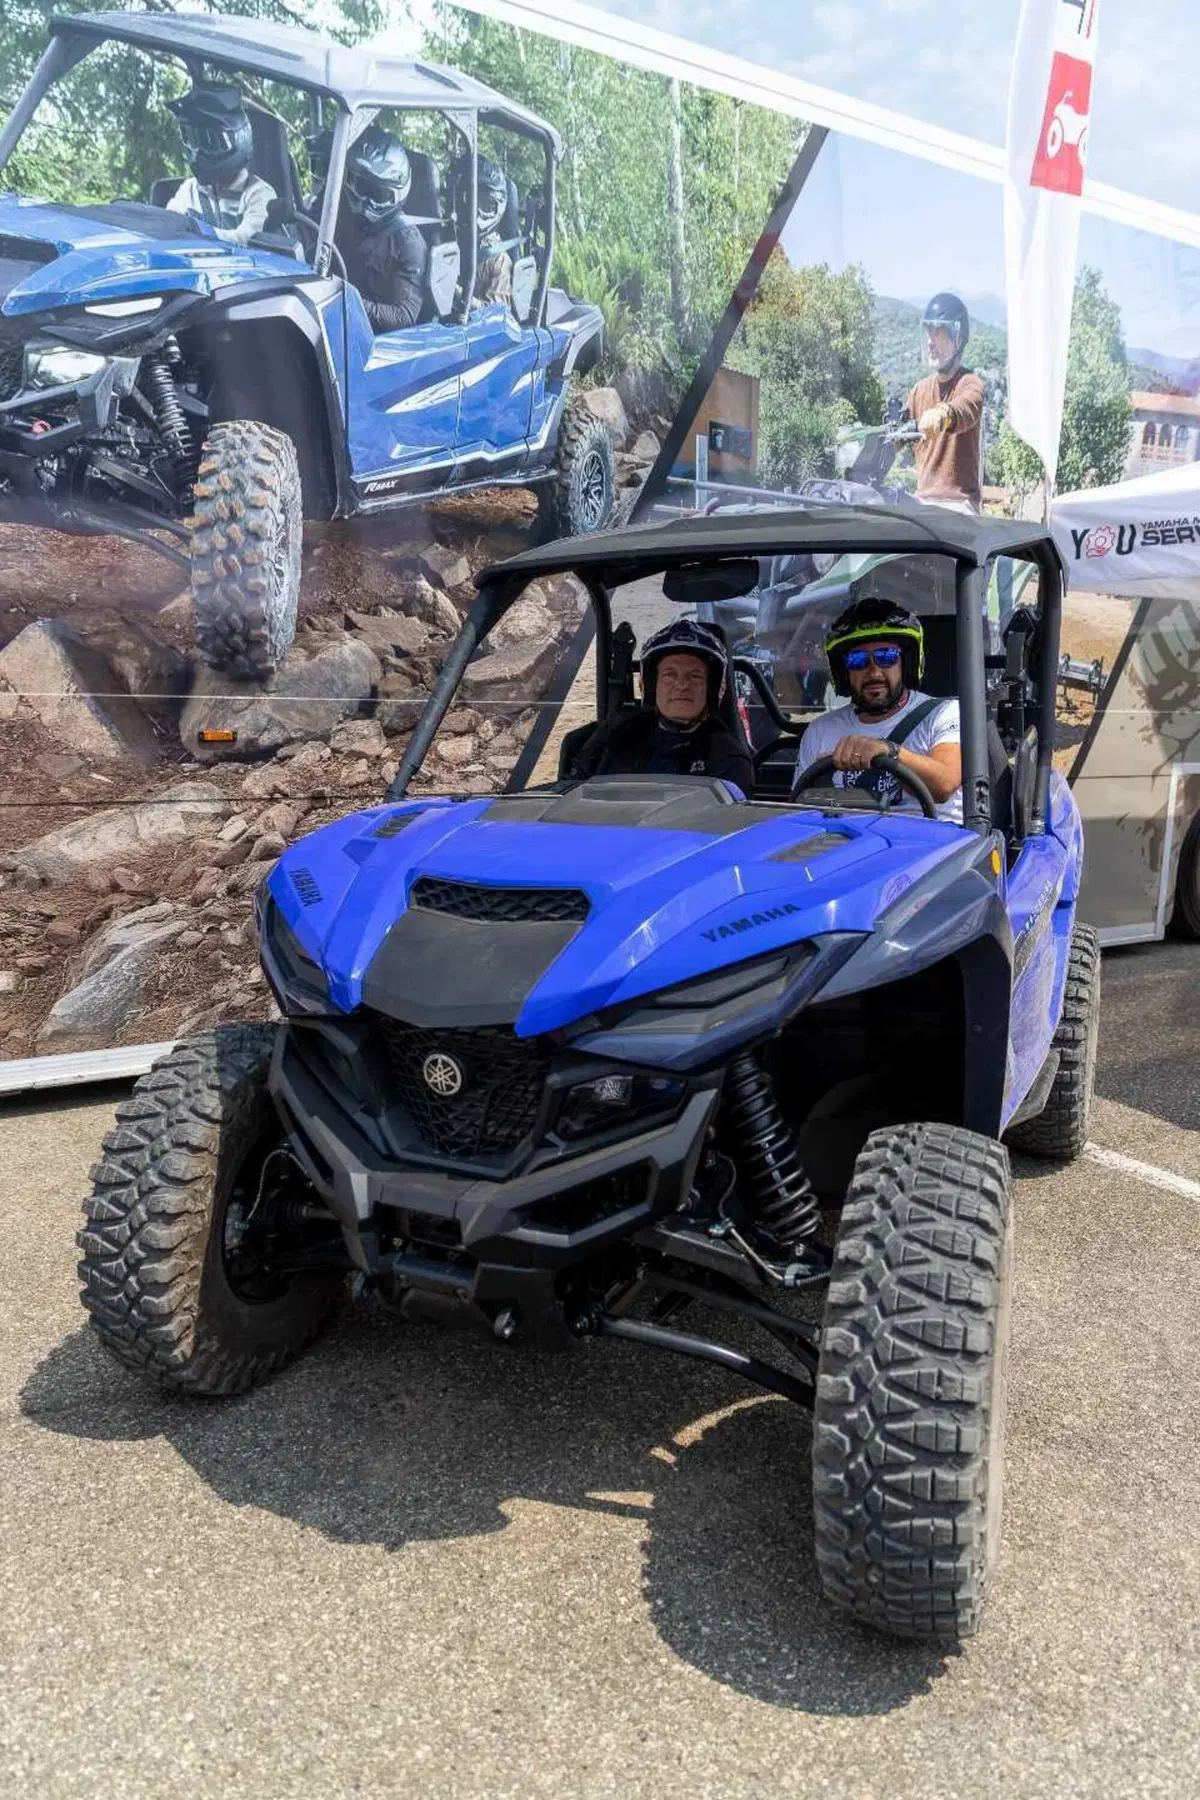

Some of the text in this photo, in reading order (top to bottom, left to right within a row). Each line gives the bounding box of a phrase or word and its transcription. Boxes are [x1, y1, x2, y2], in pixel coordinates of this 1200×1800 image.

[364, 479, 398, 493] RMAX
[1140, 517, 1190, 529] YAMAHA
[289, 867, 323, 907] YAMAHA
[700, 904, 802, 942] YAMAHA
